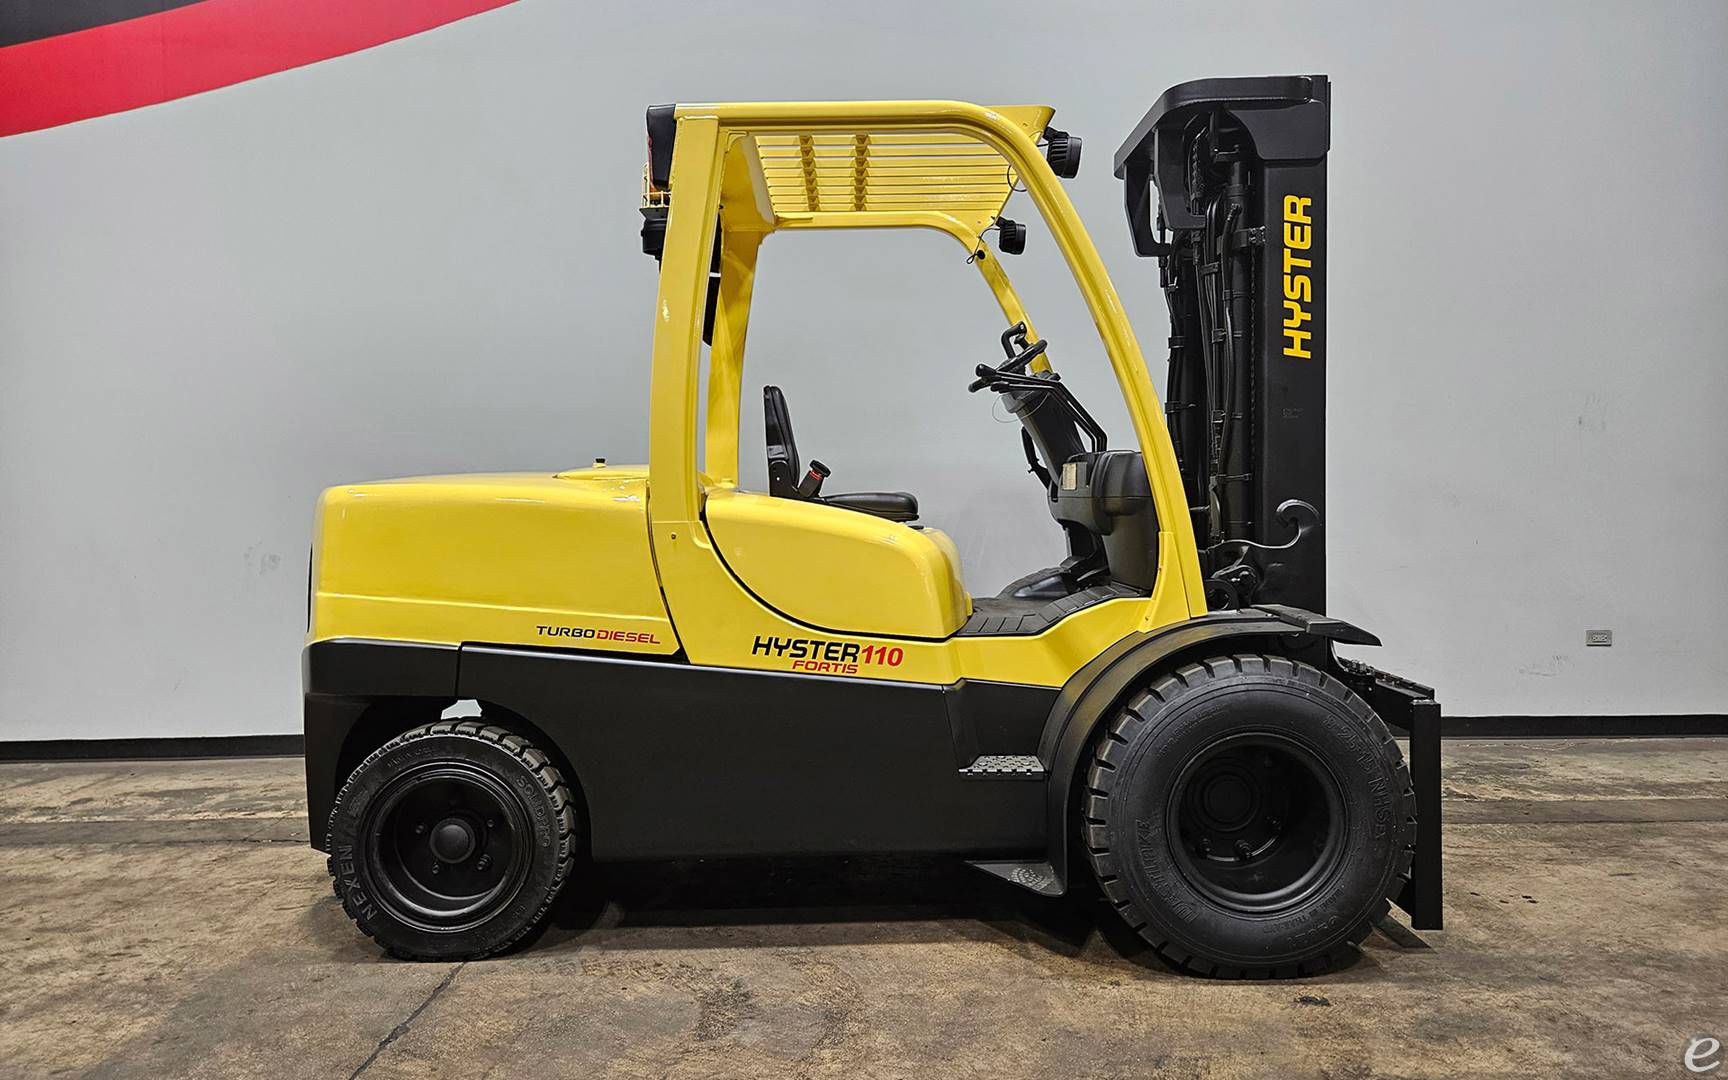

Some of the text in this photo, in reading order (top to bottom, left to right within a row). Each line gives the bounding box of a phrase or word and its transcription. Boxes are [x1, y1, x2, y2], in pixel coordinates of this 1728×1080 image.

[1283, 195, 1312, 359] HYSTER
[751, 636, 904, 667] HYSTER 110
[791, 660, 859, 674] FORTIS
[338, 844, 379, 921] NEXEN
